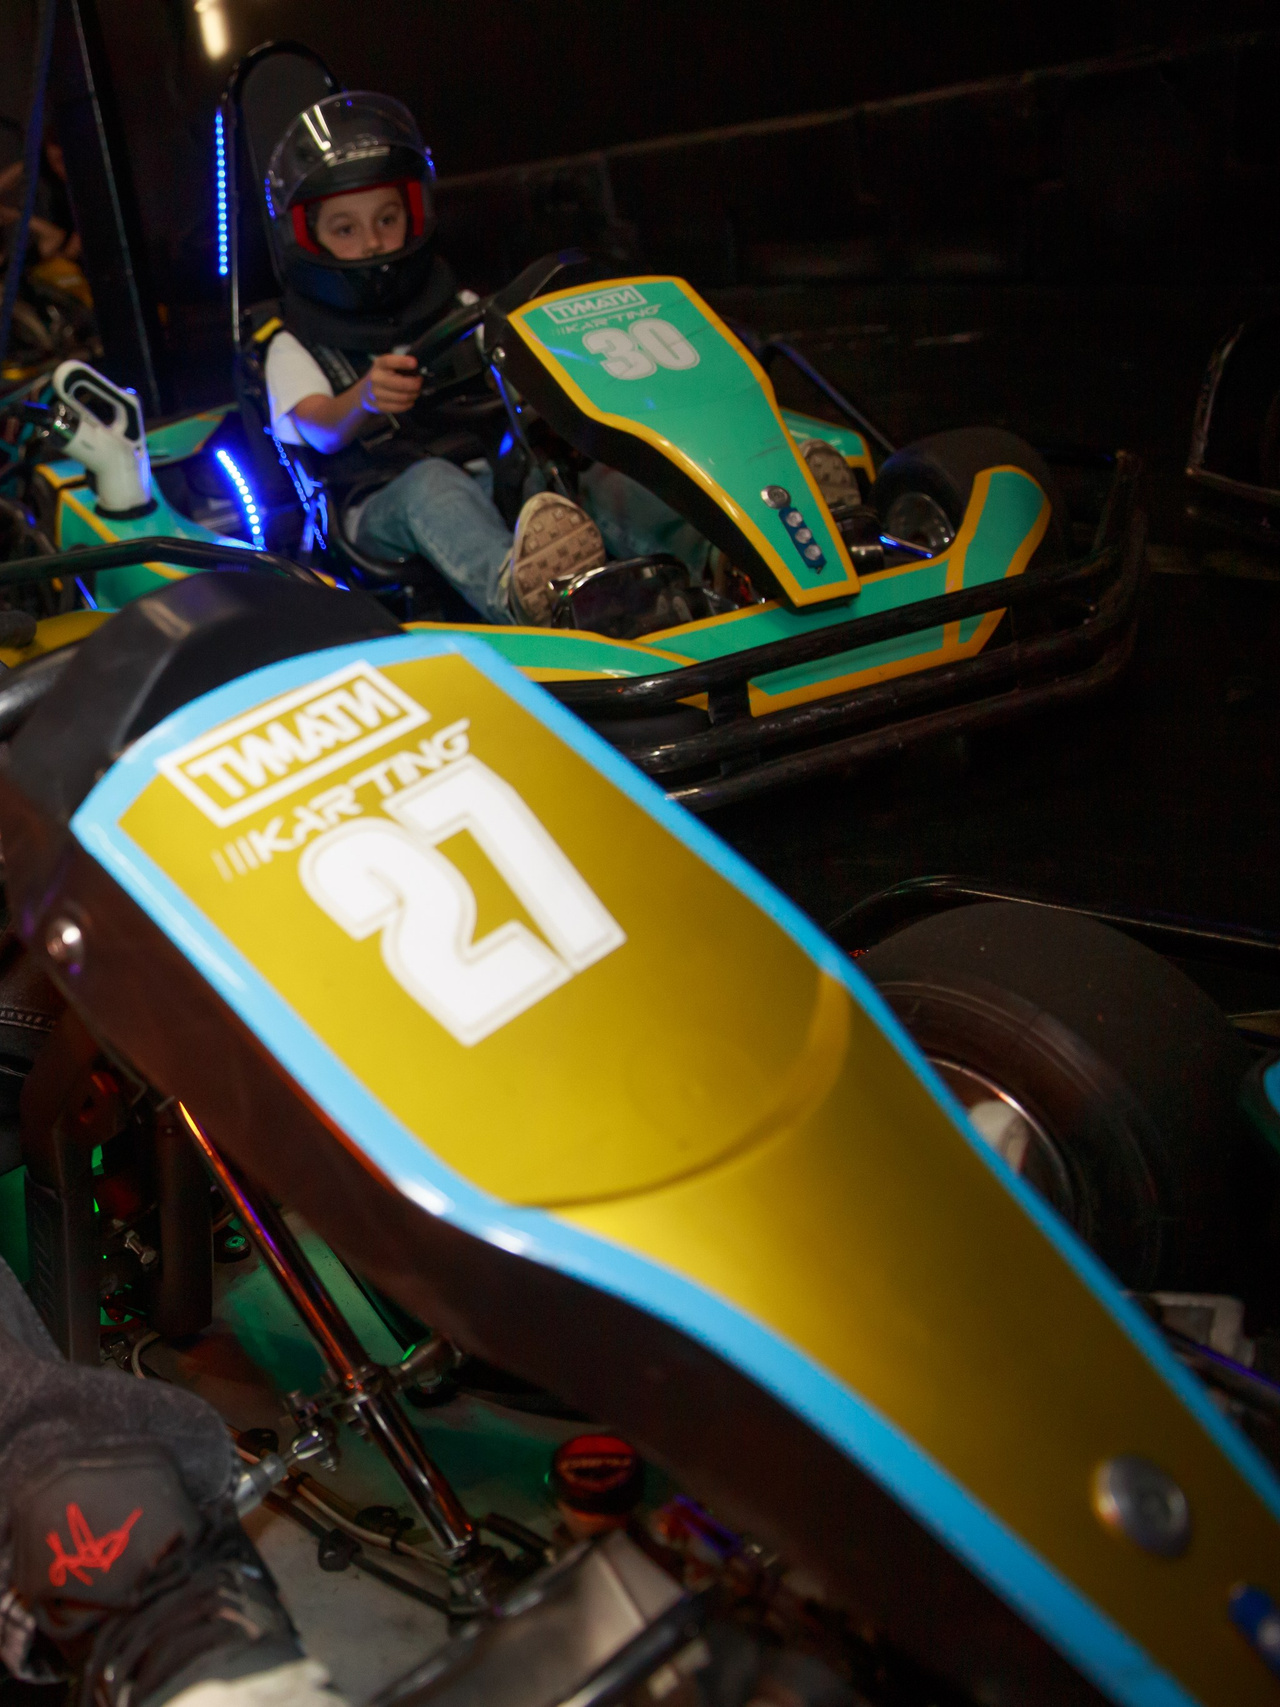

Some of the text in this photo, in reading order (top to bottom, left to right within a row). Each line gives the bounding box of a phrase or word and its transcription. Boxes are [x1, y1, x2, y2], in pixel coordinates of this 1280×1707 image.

[565, 303, 662, 334] KARTING
[581, 318, 701, 381] 30
[248, 718, 470, 863] KARTING
[297, 753, 628, 1048] 27
